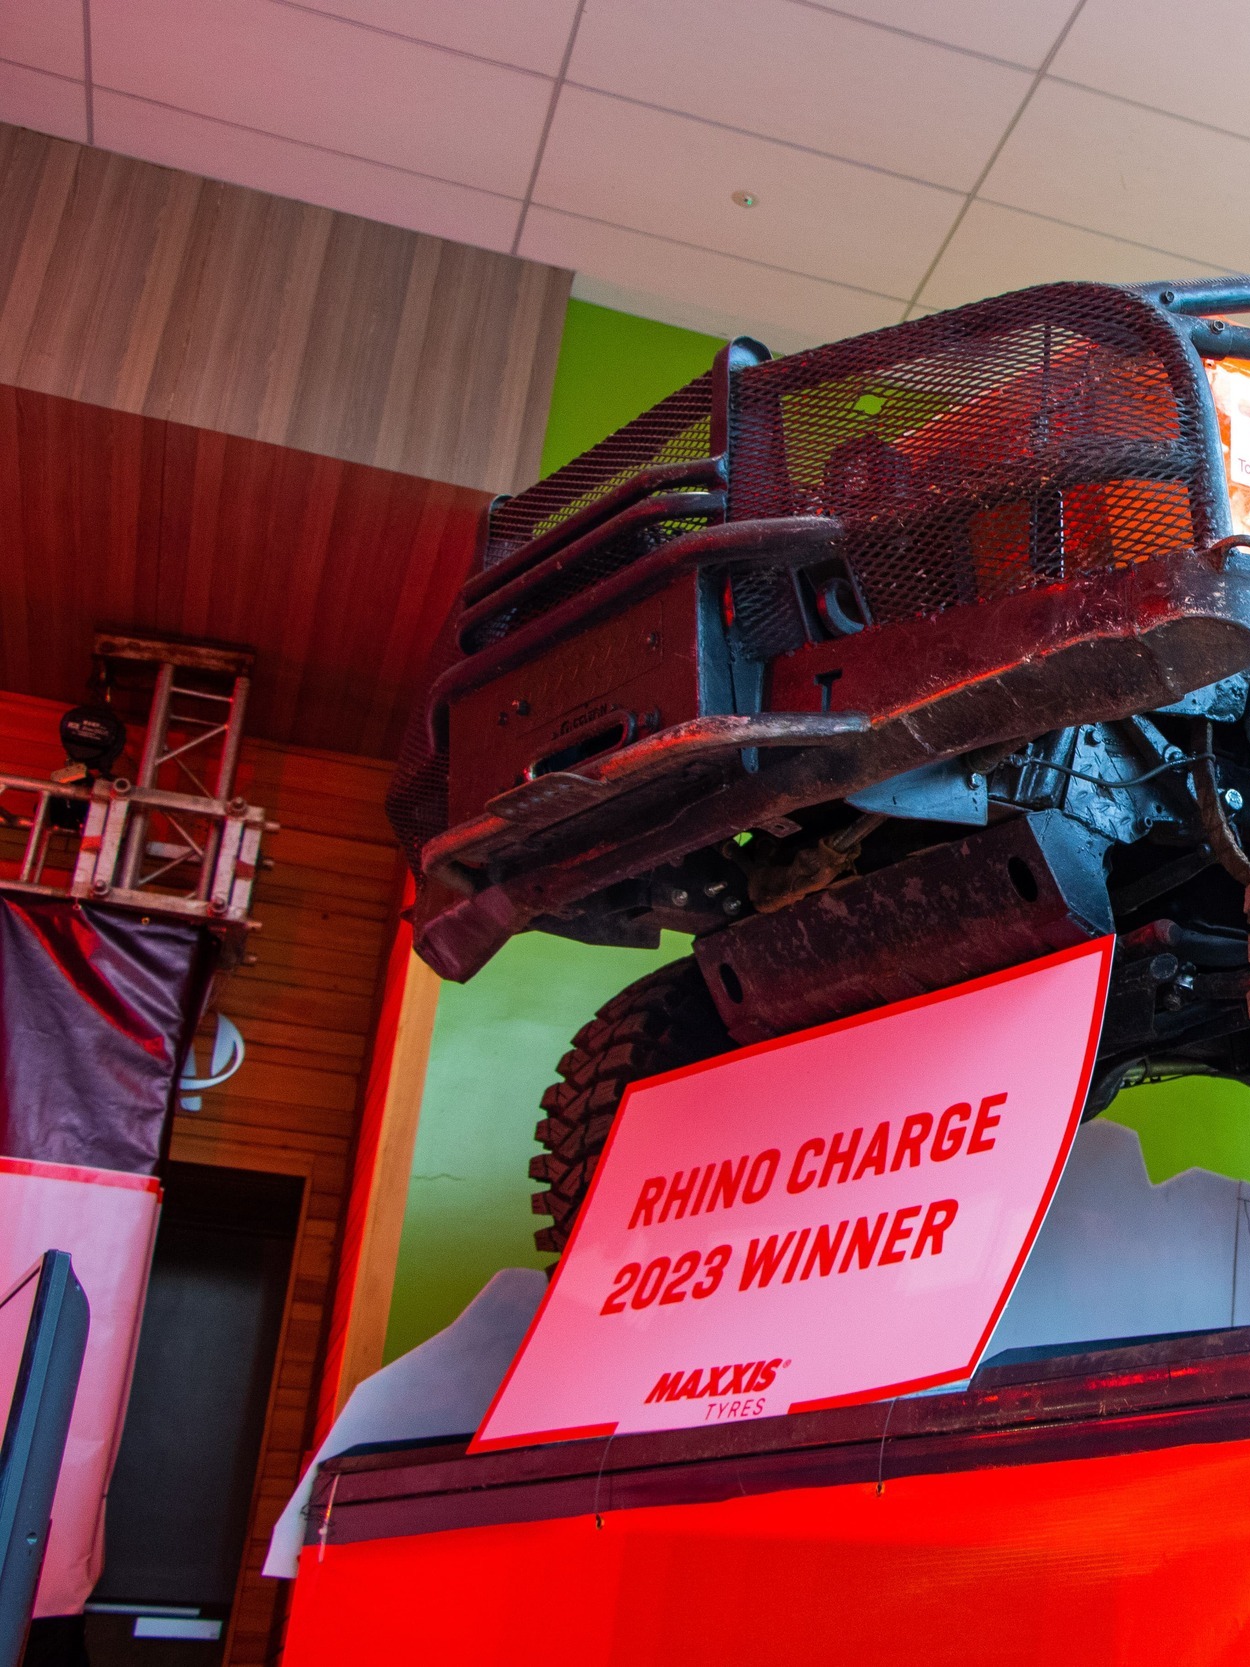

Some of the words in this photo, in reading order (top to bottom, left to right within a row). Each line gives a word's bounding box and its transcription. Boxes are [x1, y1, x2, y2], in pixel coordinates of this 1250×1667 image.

[627, 1148, 781, 1230] RHINO
[786, 1092, 1008, 1195] CHARGE
[599, 1244, 732, 1316] 2023
[738, 1199, 959, 1292] WINNER
[704, 1397, 766, 1420] TYRES
